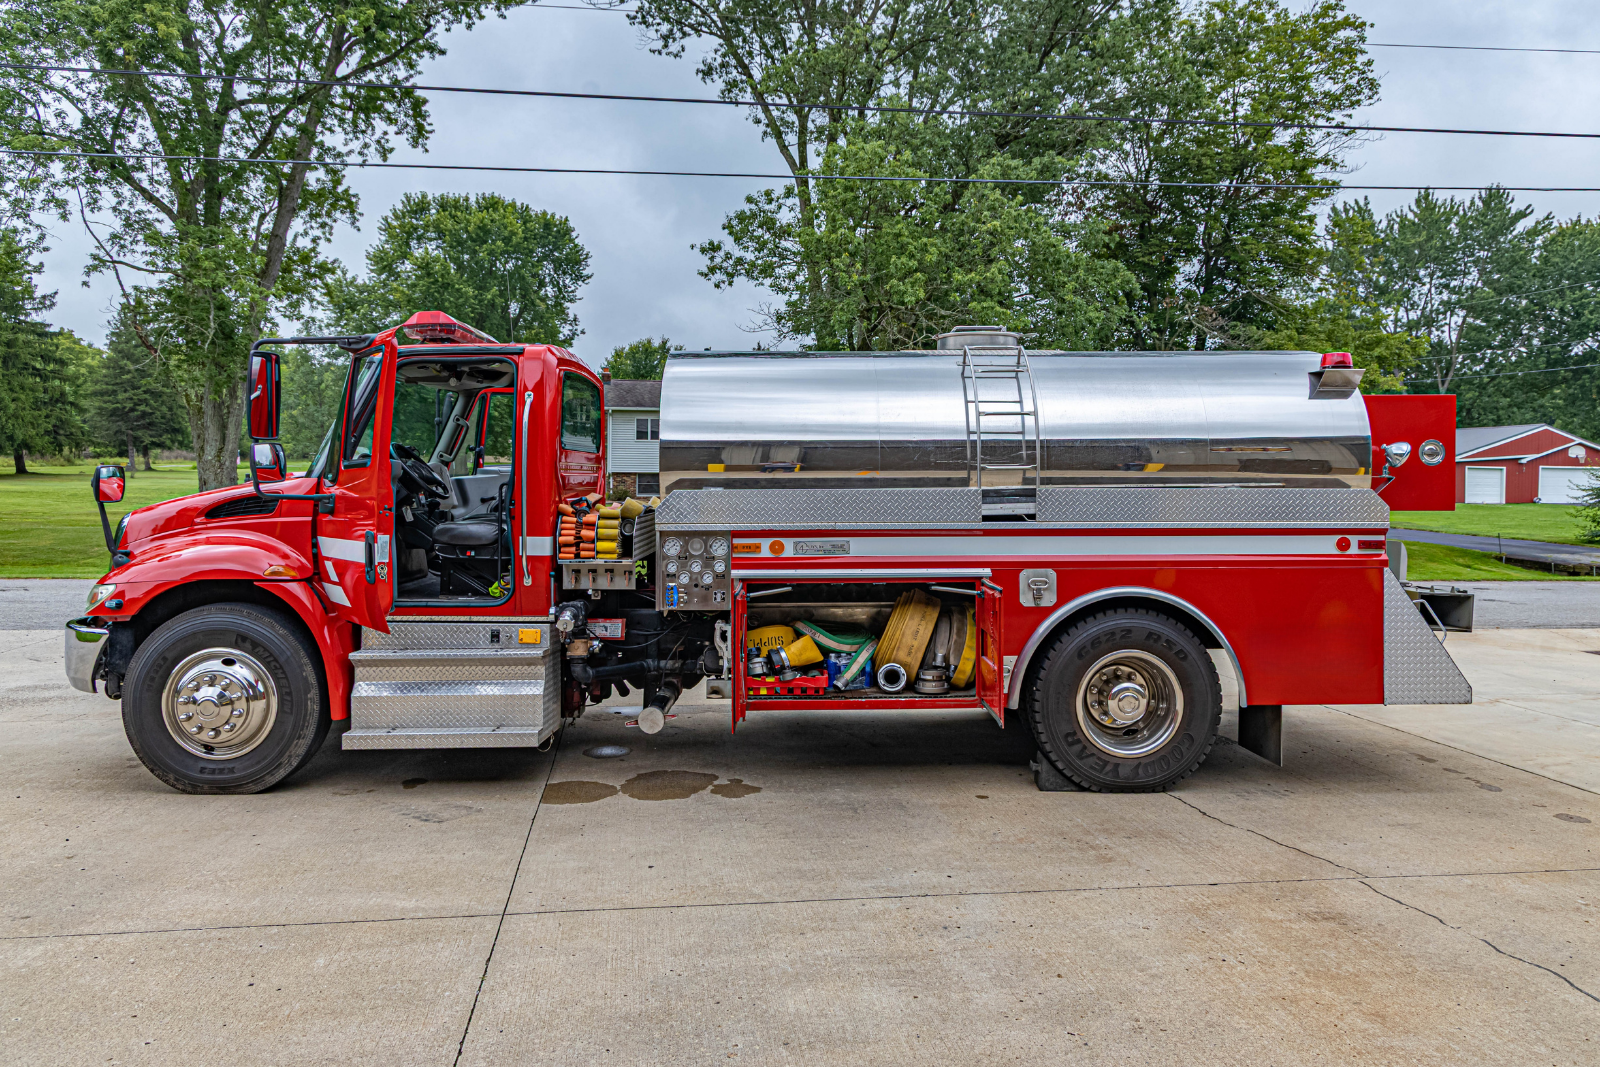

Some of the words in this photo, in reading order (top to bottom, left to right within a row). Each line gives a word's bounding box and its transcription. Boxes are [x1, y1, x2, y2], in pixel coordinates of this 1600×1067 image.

[1076, 628, 1133, 661] G622
[1144, 631, 1188, 662] RSD
[254, 646, 294, 715] MICHELIN
[199, 766, 236, 774] XZE2
